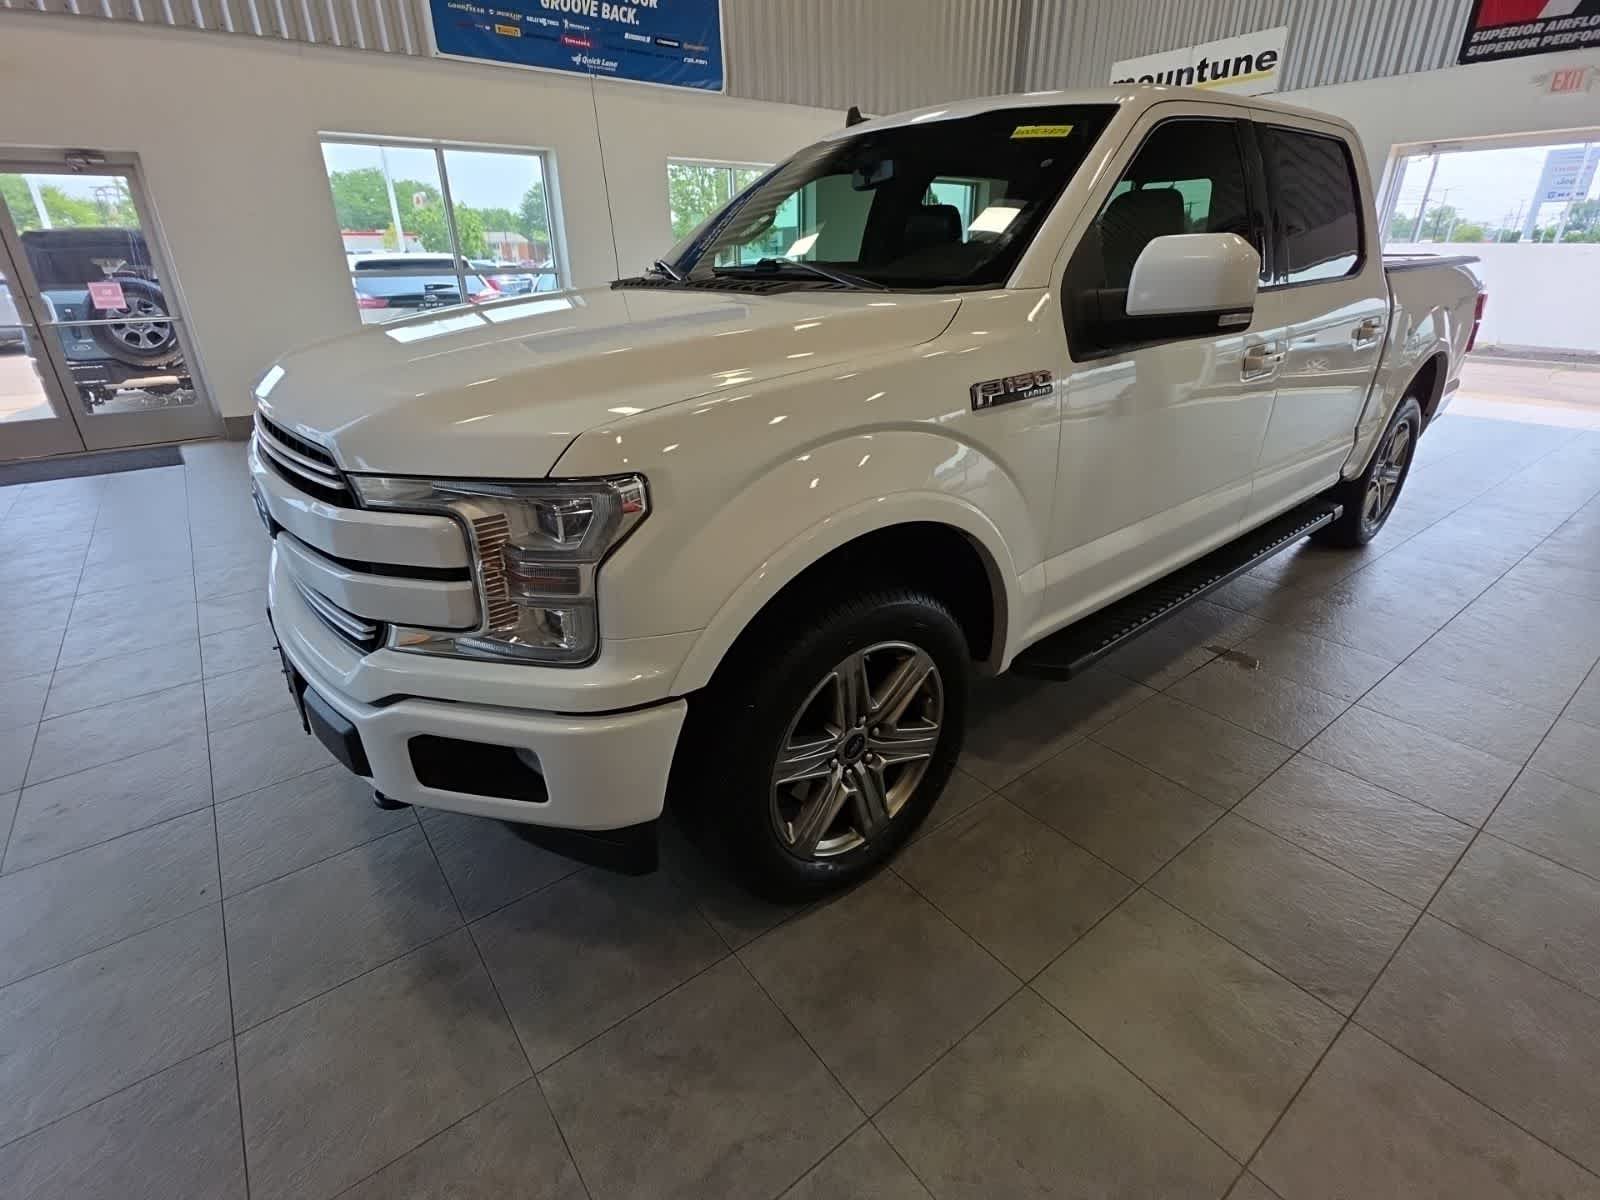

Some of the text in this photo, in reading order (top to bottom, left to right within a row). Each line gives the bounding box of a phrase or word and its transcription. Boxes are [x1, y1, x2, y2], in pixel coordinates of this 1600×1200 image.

[540, 0, 598, 17] GROOVE
[601, 2, 640, 25] BACK.
[1471, 23, 1545, 43] SUPERIOR
[1466, 37, 1540, 57] SUPERIOR
[581, 55, 601, 65] Quick
[601, 58, 618, 68] Lane
[1551, 71, 1584, 90] EXIT
